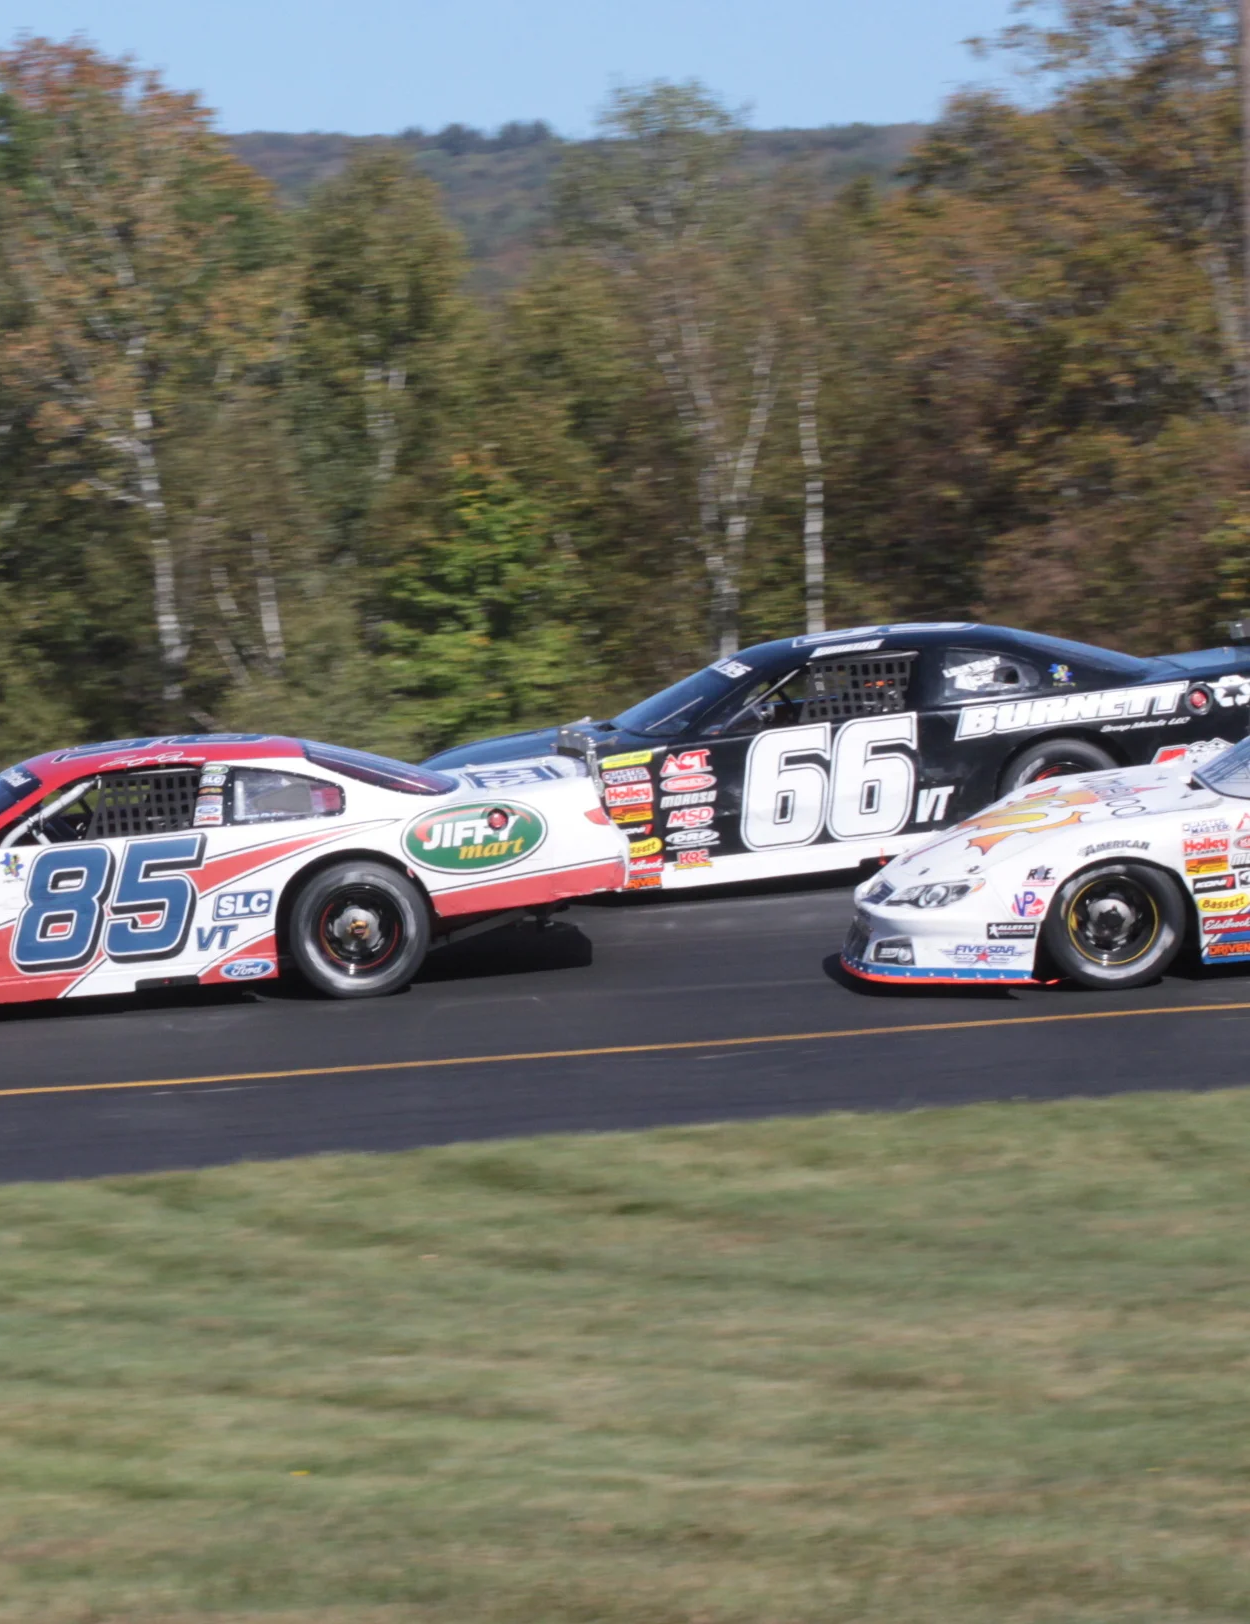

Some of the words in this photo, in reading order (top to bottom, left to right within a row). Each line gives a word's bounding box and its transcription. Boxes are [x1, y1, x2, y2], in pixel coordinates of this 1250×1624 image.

[954, 680, 1190, 741] BURNETT
[660, 750, 711, 776] ACT
[740, 711, 918, 851] 66
[607, 787, 651, 801] Holley
[660, 790, 717, 809] MOROSO
[915, 785, 955, 823] VT
[667, 807, 714, 826] MSD
[423, 814, 520, 850] JIFFY
[458, 836, 526, 860] mart
[630, 841, 657, 854] ssett
[1084, 840, 1151, 857] AMERICAN
[1184, 837, 1228, 852] Holley
[11, 833, 207, 976] 85
[217, 892, 270, 916] SLC
[1014, 891, 1036, 917] VP
[1202, 896, 1245, 909] Bassett
[196, 924, 239, 952] VT
[955, 944, 984, 955] FIVE
[987, 945, 1016, 954] STAR
[230, 961, 264, 976] Ford
